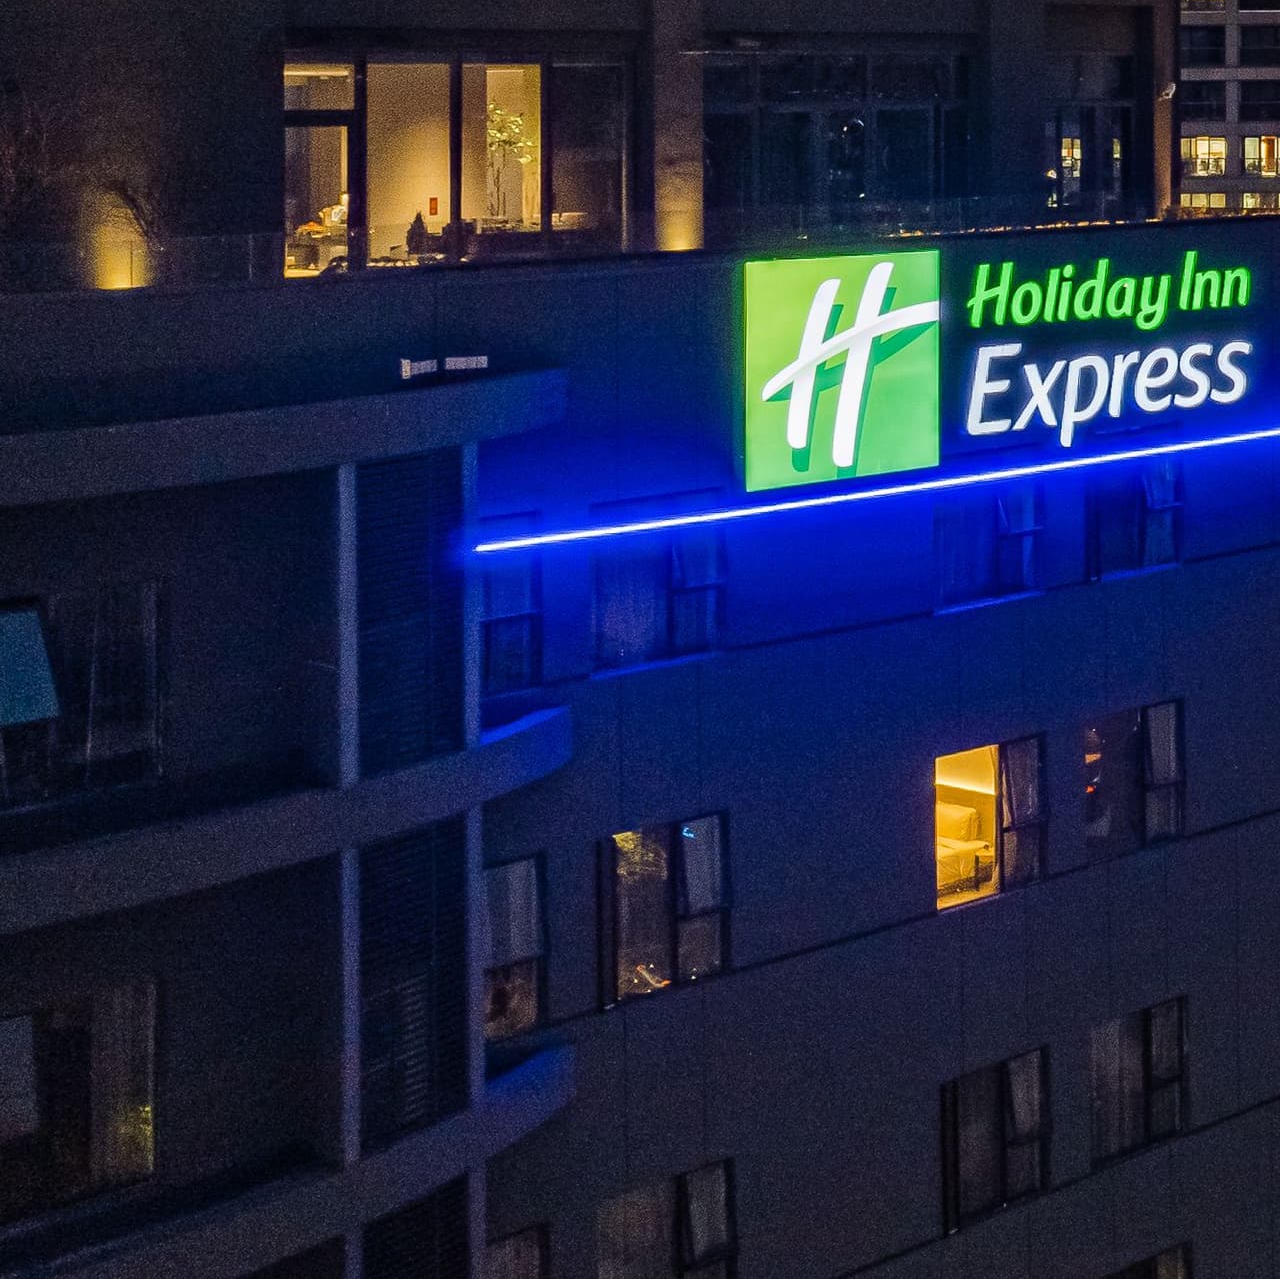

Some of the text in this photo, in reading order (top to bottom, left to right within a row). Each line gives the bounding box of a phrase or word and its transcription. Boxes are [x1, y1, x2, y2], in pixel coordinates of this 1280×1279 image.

[966, 250, 1251, 331] Holiday Inn
[965, 340, 1253, 448] Express
